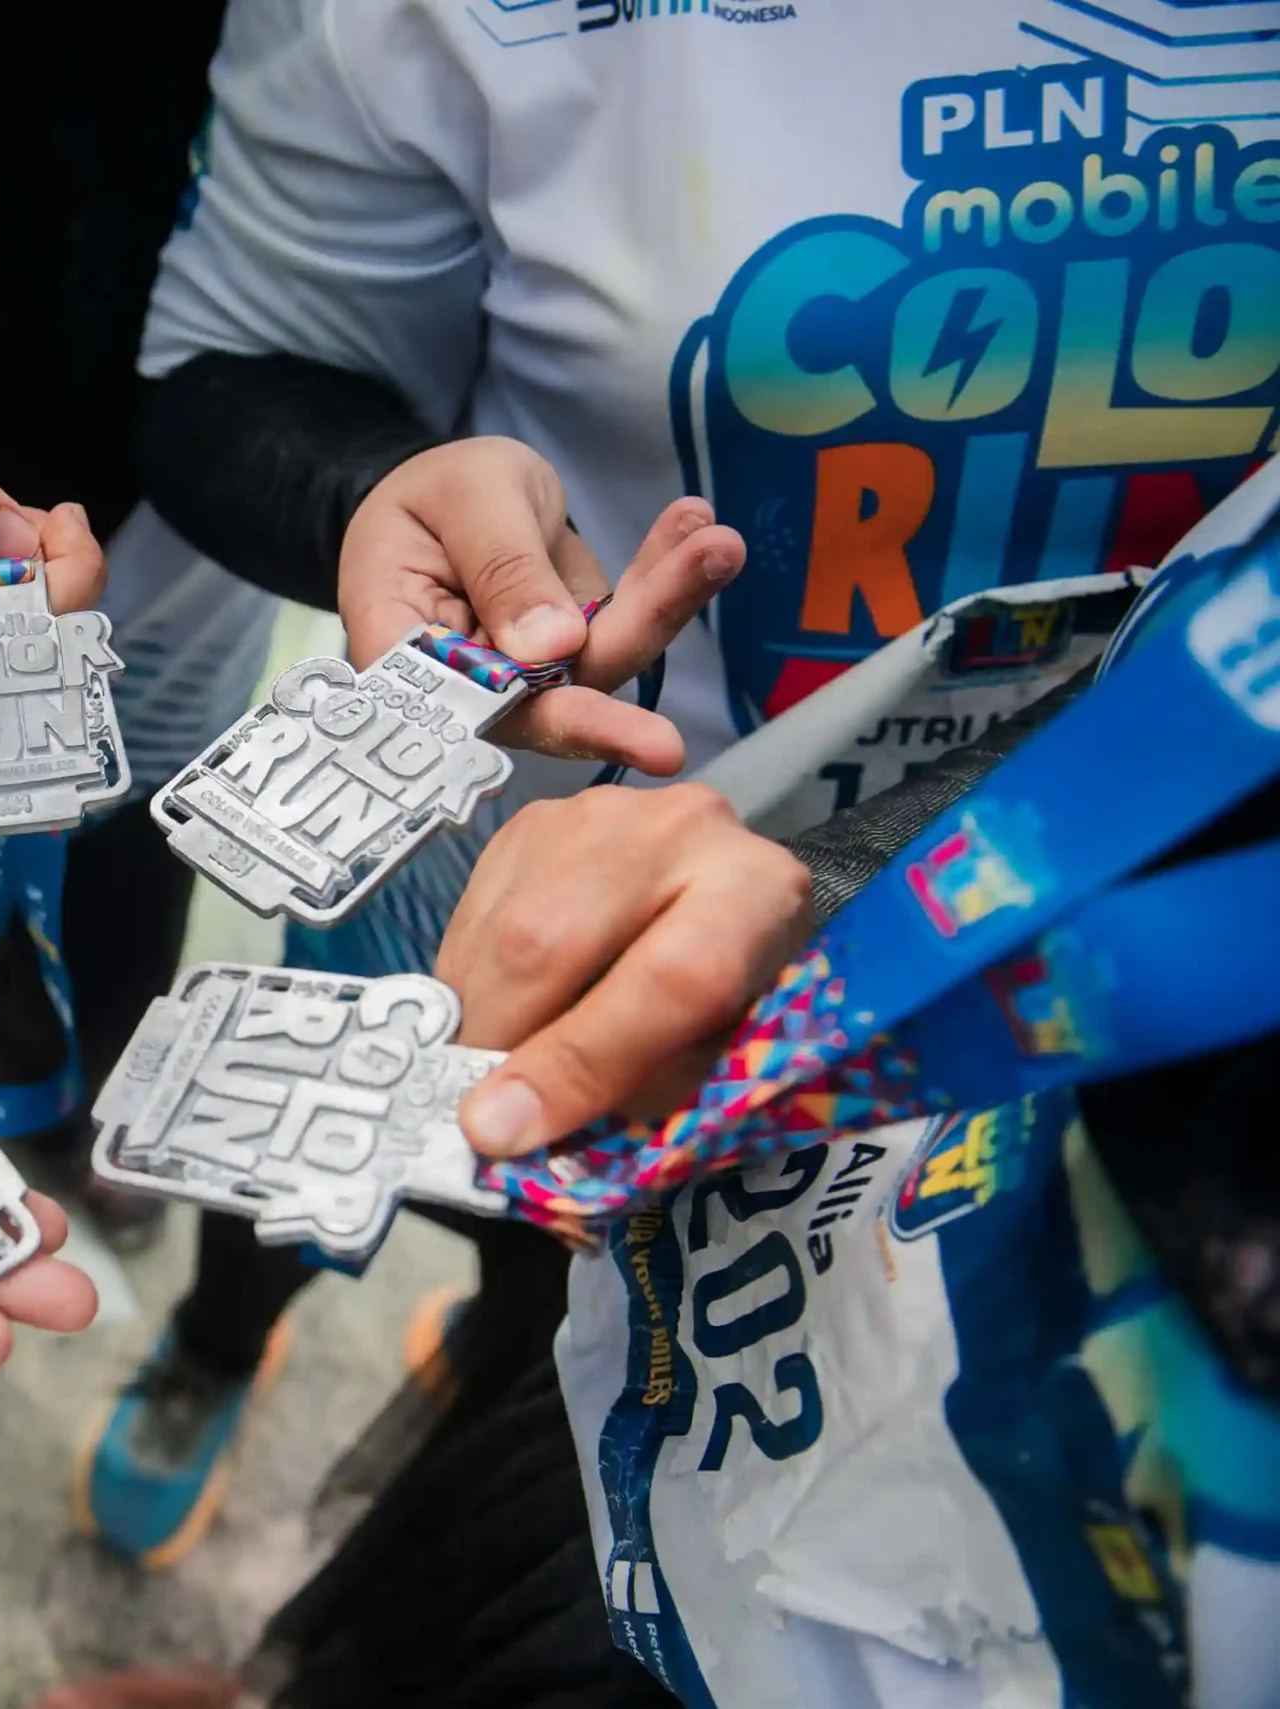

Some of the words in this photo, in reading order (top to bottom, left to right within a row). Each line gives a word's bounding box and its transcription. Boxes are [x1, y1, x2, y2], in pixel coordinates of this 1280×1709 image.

[923, 76, 1104, 156] PLN
[923, 143, 1280, 254] mobile
[726, 230, 1280, 468] COLO
[358, 675, 469, 744] mobile
[382, 651, 446, 694] PLN
[220, 714, 405, 860] RUN
[272, 657, 503, 817] COLOR
[200, 790, 246, 823] COLOR
[169, 990, 353, 1171] RUN
[258, 974, 452, 1235] COLOR
[808, 1143, 888, 1275] Allia
[630, 1249, 662, 1321] YOUR
[641, 1325, 673, 1406] MILES
